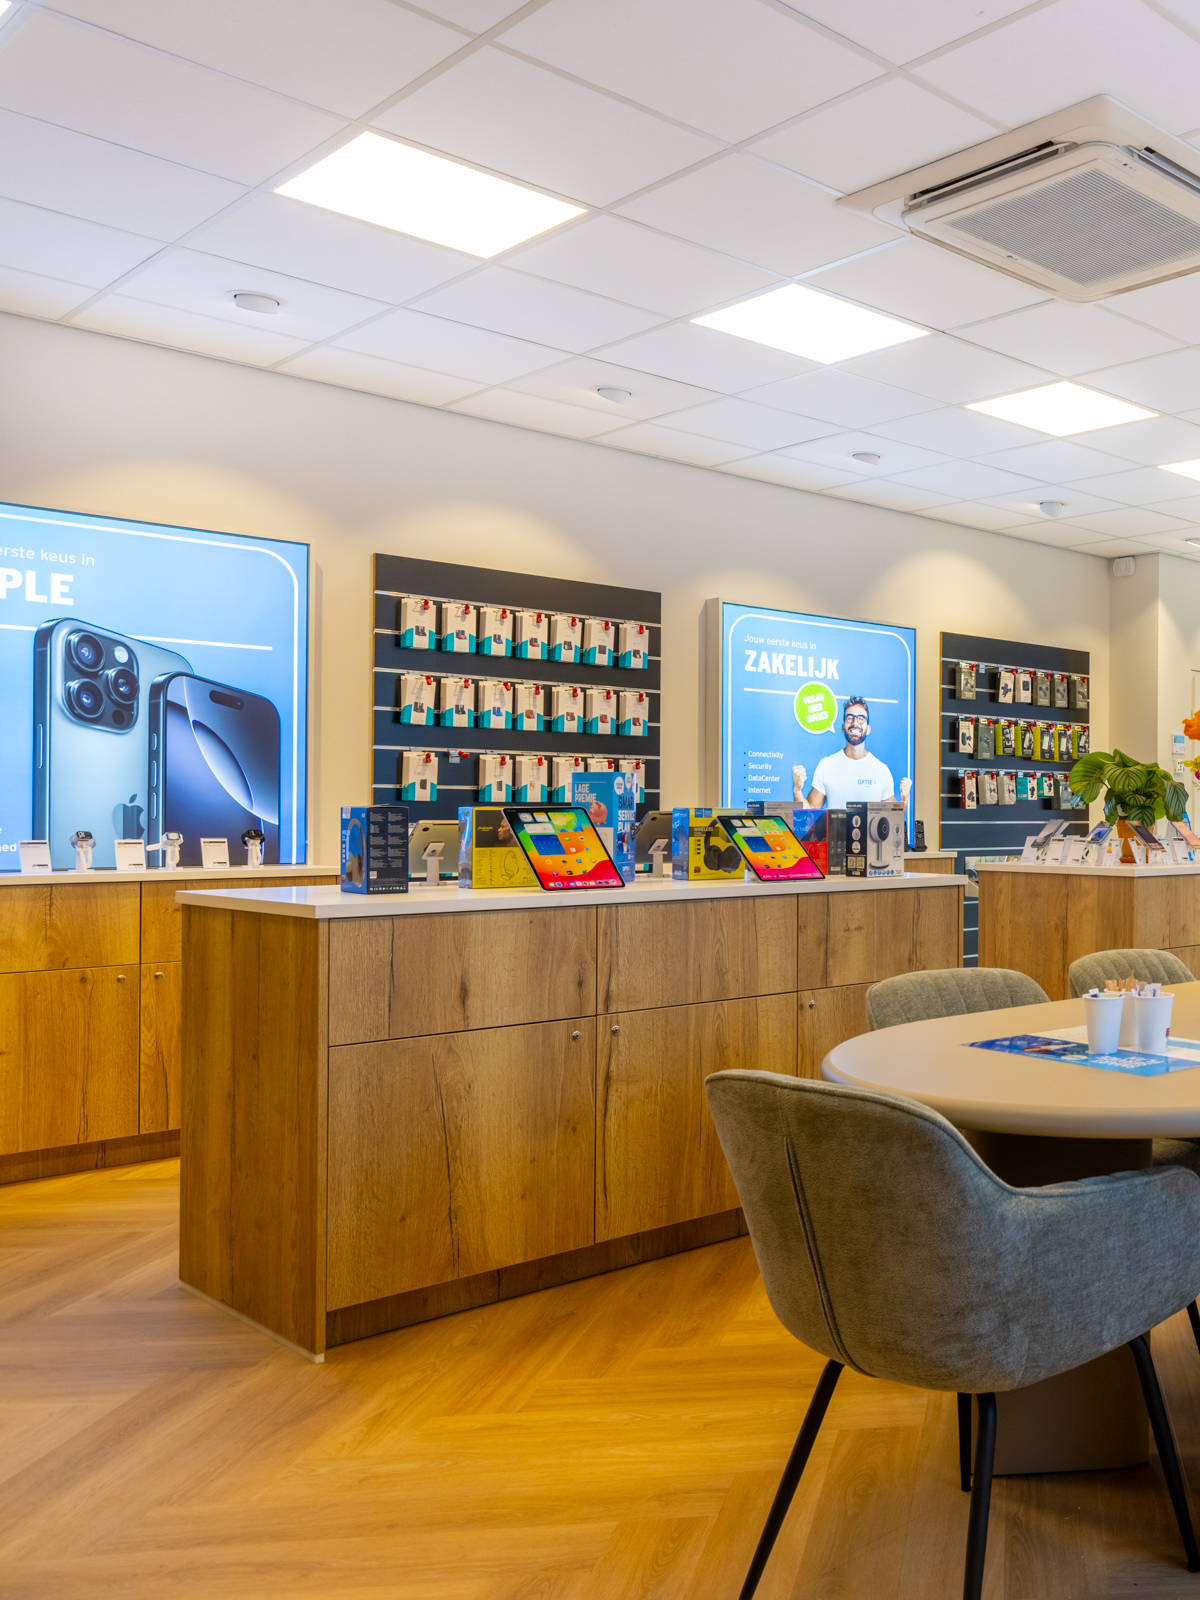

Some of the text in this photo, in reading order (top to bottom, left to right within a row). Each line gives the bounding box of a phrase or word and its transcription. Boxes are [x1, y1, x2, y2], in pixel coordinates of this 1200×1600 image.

[40, 549, 77, 564] keus
[81, 553, 95, 566] in
[744, 634, 817, 650] Jouw eerste keus in
[744, 649, 840, 680] ZAKELIJK
[802, 693, 825, 705] VRAAG
[807, 703, 823, 713] HIER
[806, 711, 829, 724] ADVIES
[748, 750, 784, 760] Connectivity
[748, 762, 772, 771] Security
[748, 774, 780, 782] DataCenter
[574, 783, 590, 793] LAGE
[574, 793, 597, 803] PREMIE
